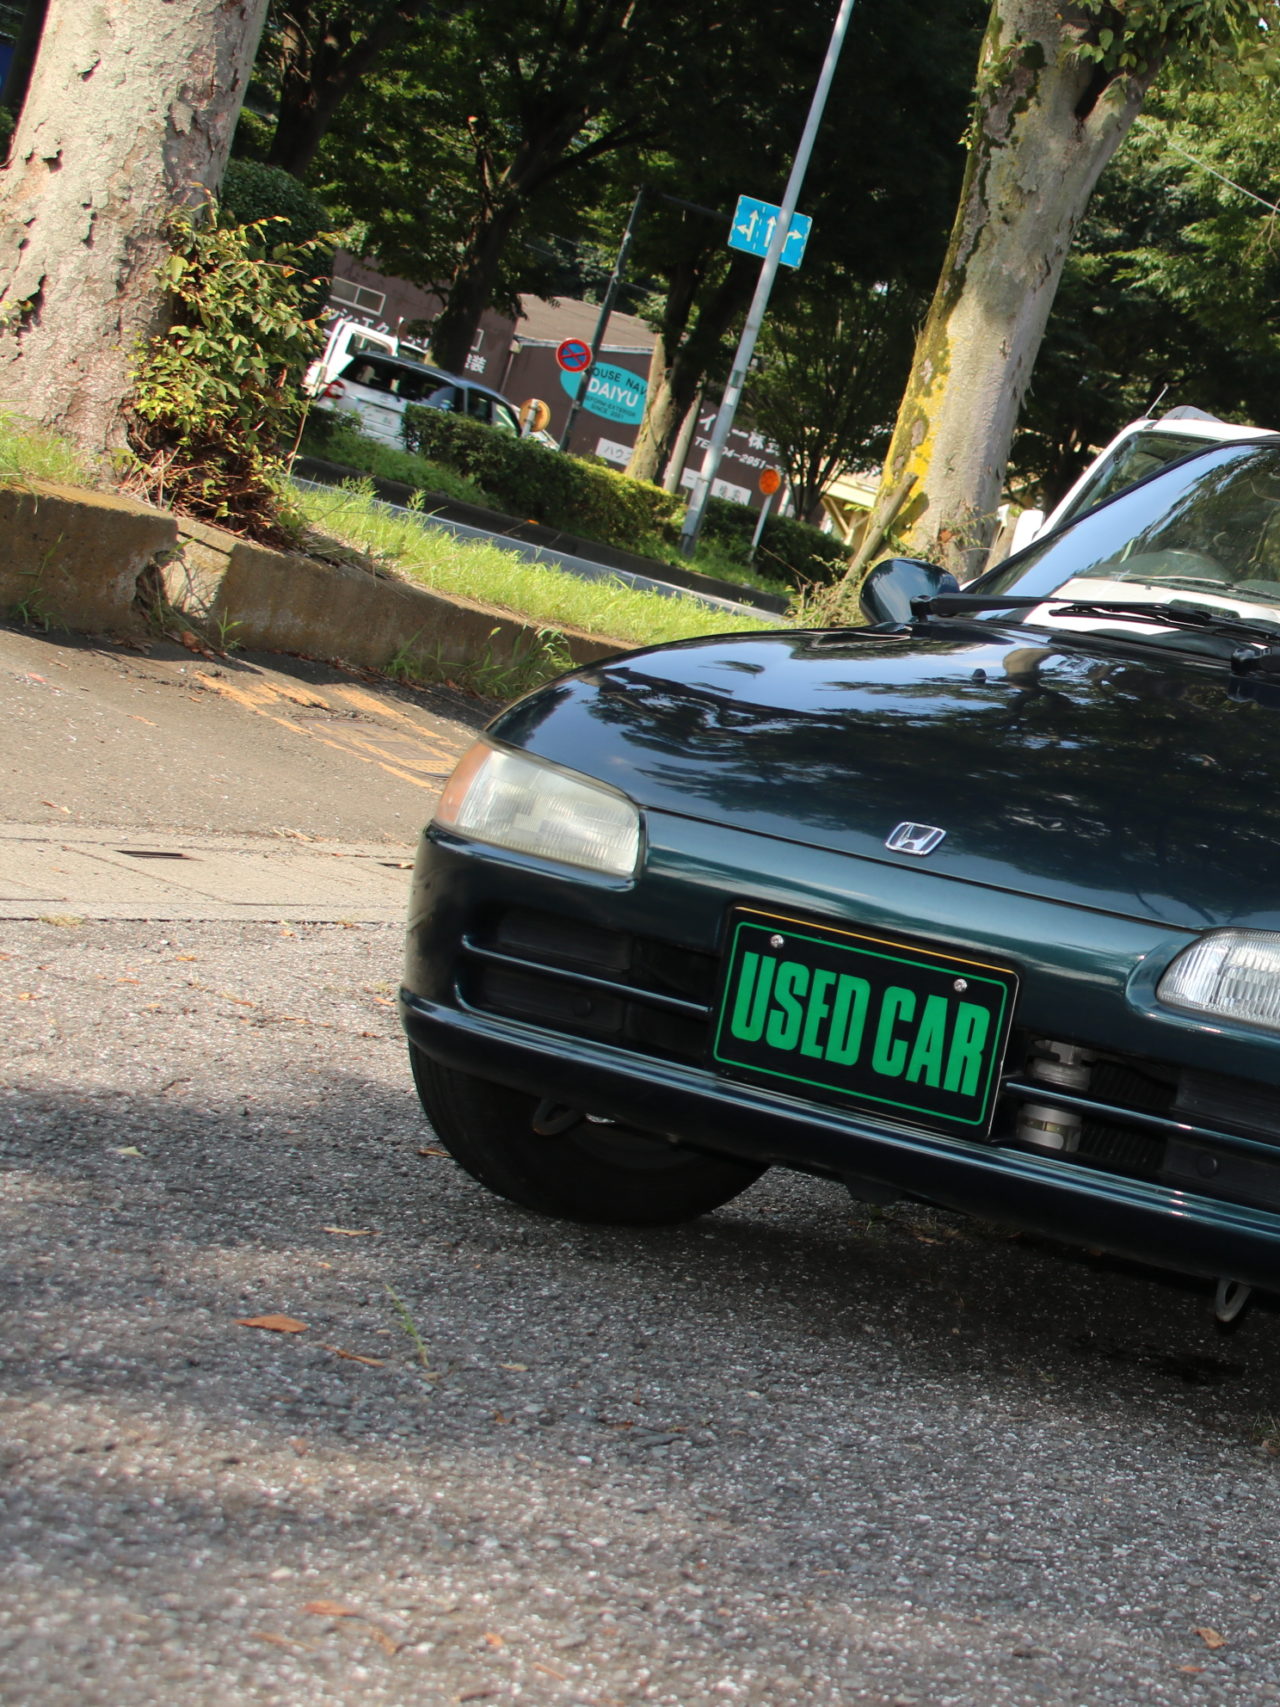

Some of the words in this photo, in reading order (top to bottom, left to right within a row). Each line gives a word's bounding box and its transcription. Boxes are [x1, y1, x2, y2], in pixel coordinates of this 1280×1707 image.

[591, 367, 622, 383] OUSE
[587, 376, 639, 408] DAIYU
[694, 436, 714, 450] TE
[730, 951, 871, 1067] USED
[871, 985, 991, 1097] CAR
